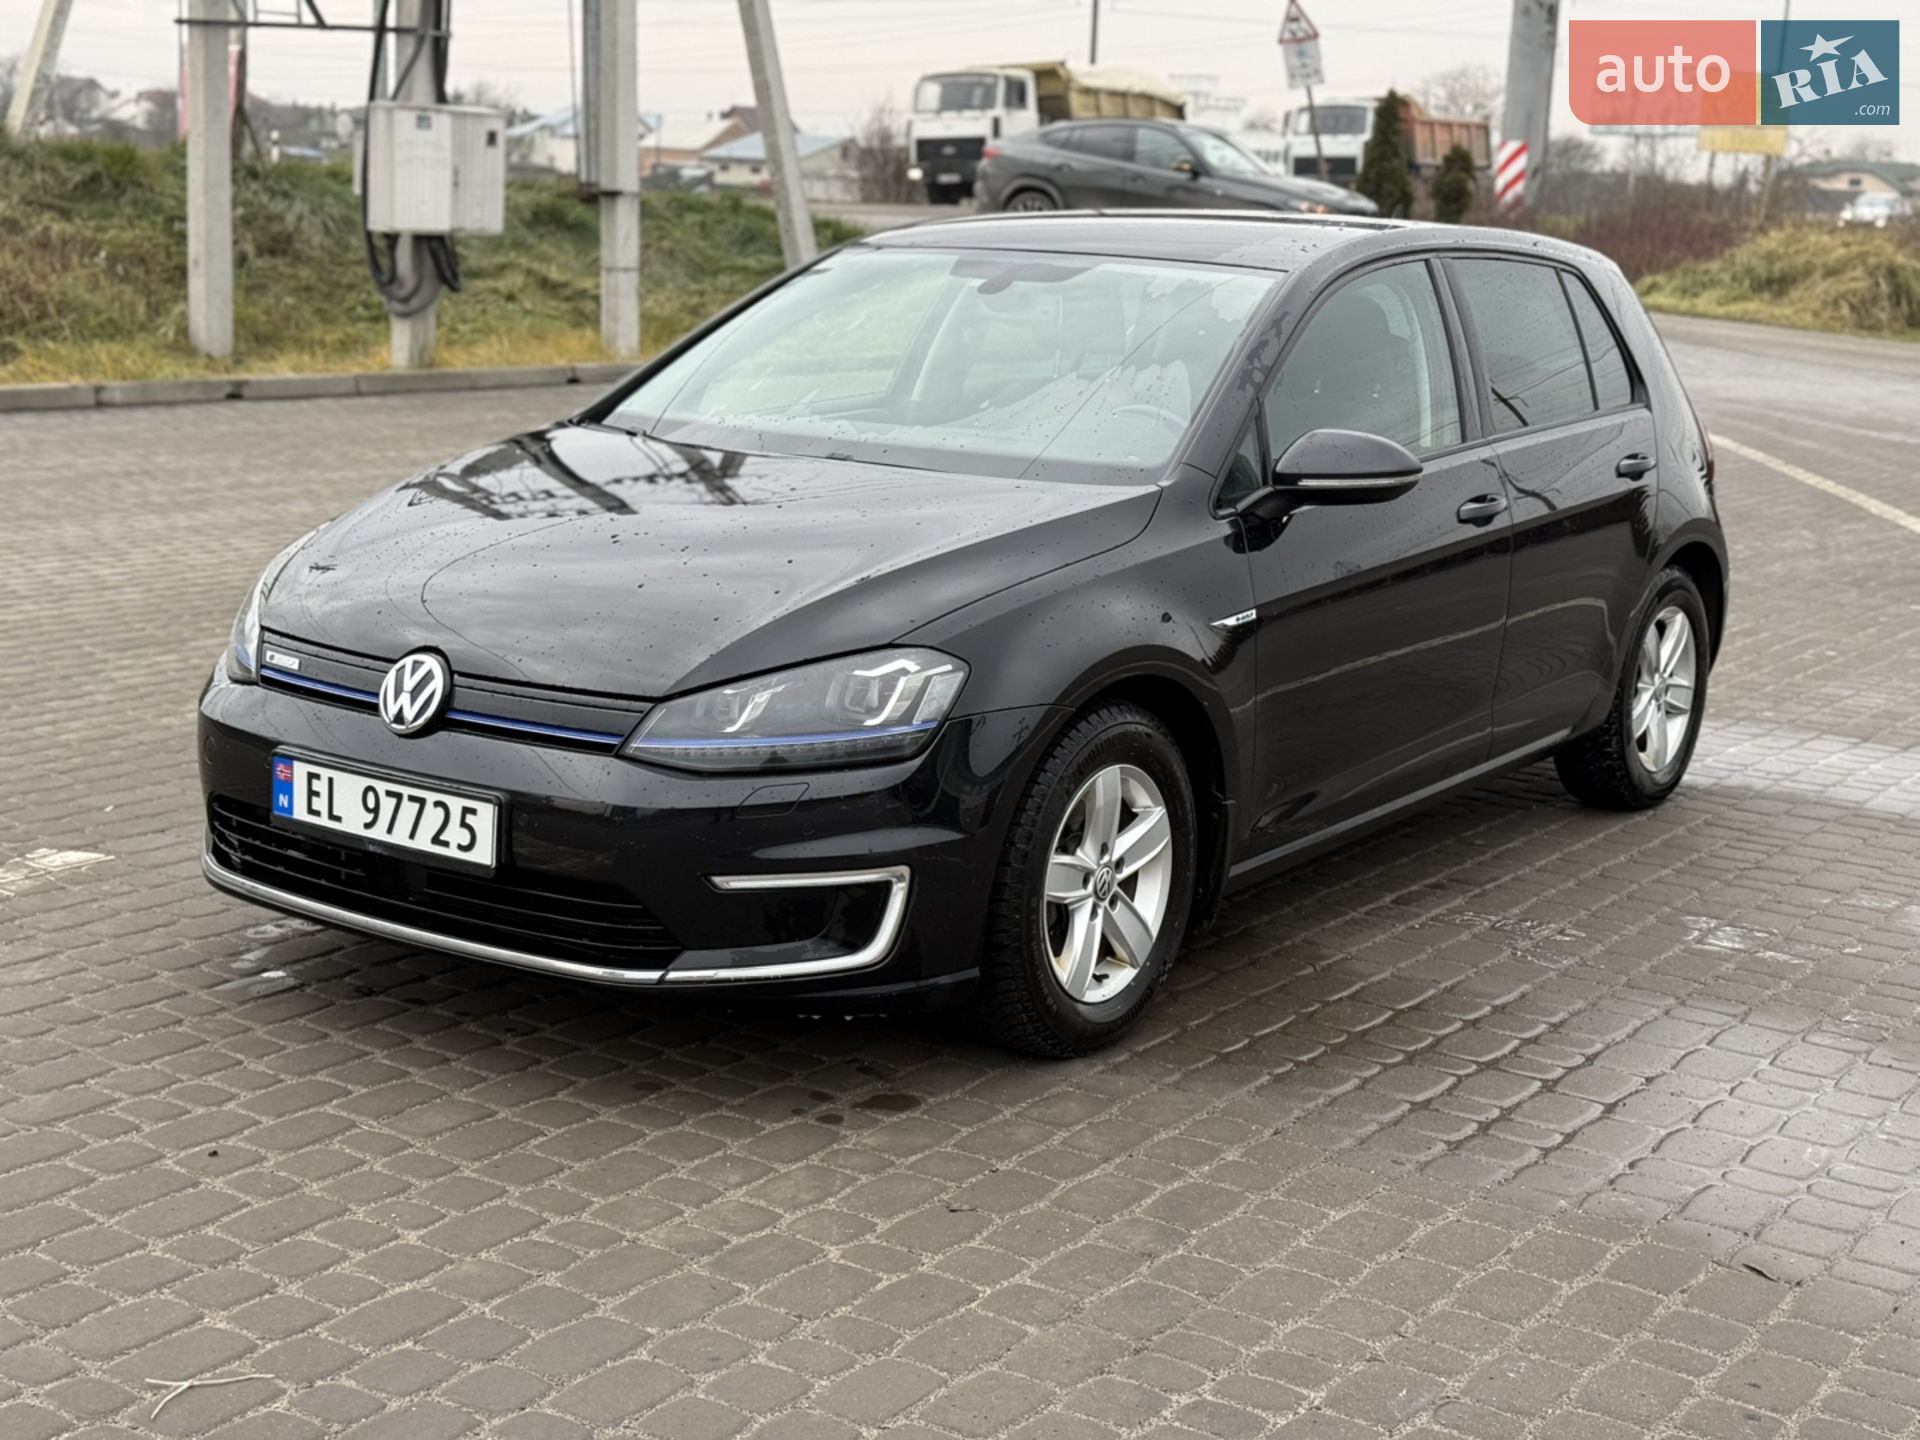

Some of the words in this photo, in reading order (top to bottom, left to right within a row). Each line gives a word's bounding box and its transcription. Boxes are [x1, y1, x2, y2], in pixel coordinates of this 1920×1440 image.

[379, 653, 444, 730] VW
[278, 793, 289, 809] N
[307, 771, 342, 823] EL
[361, 784, 478, 853] 97725
